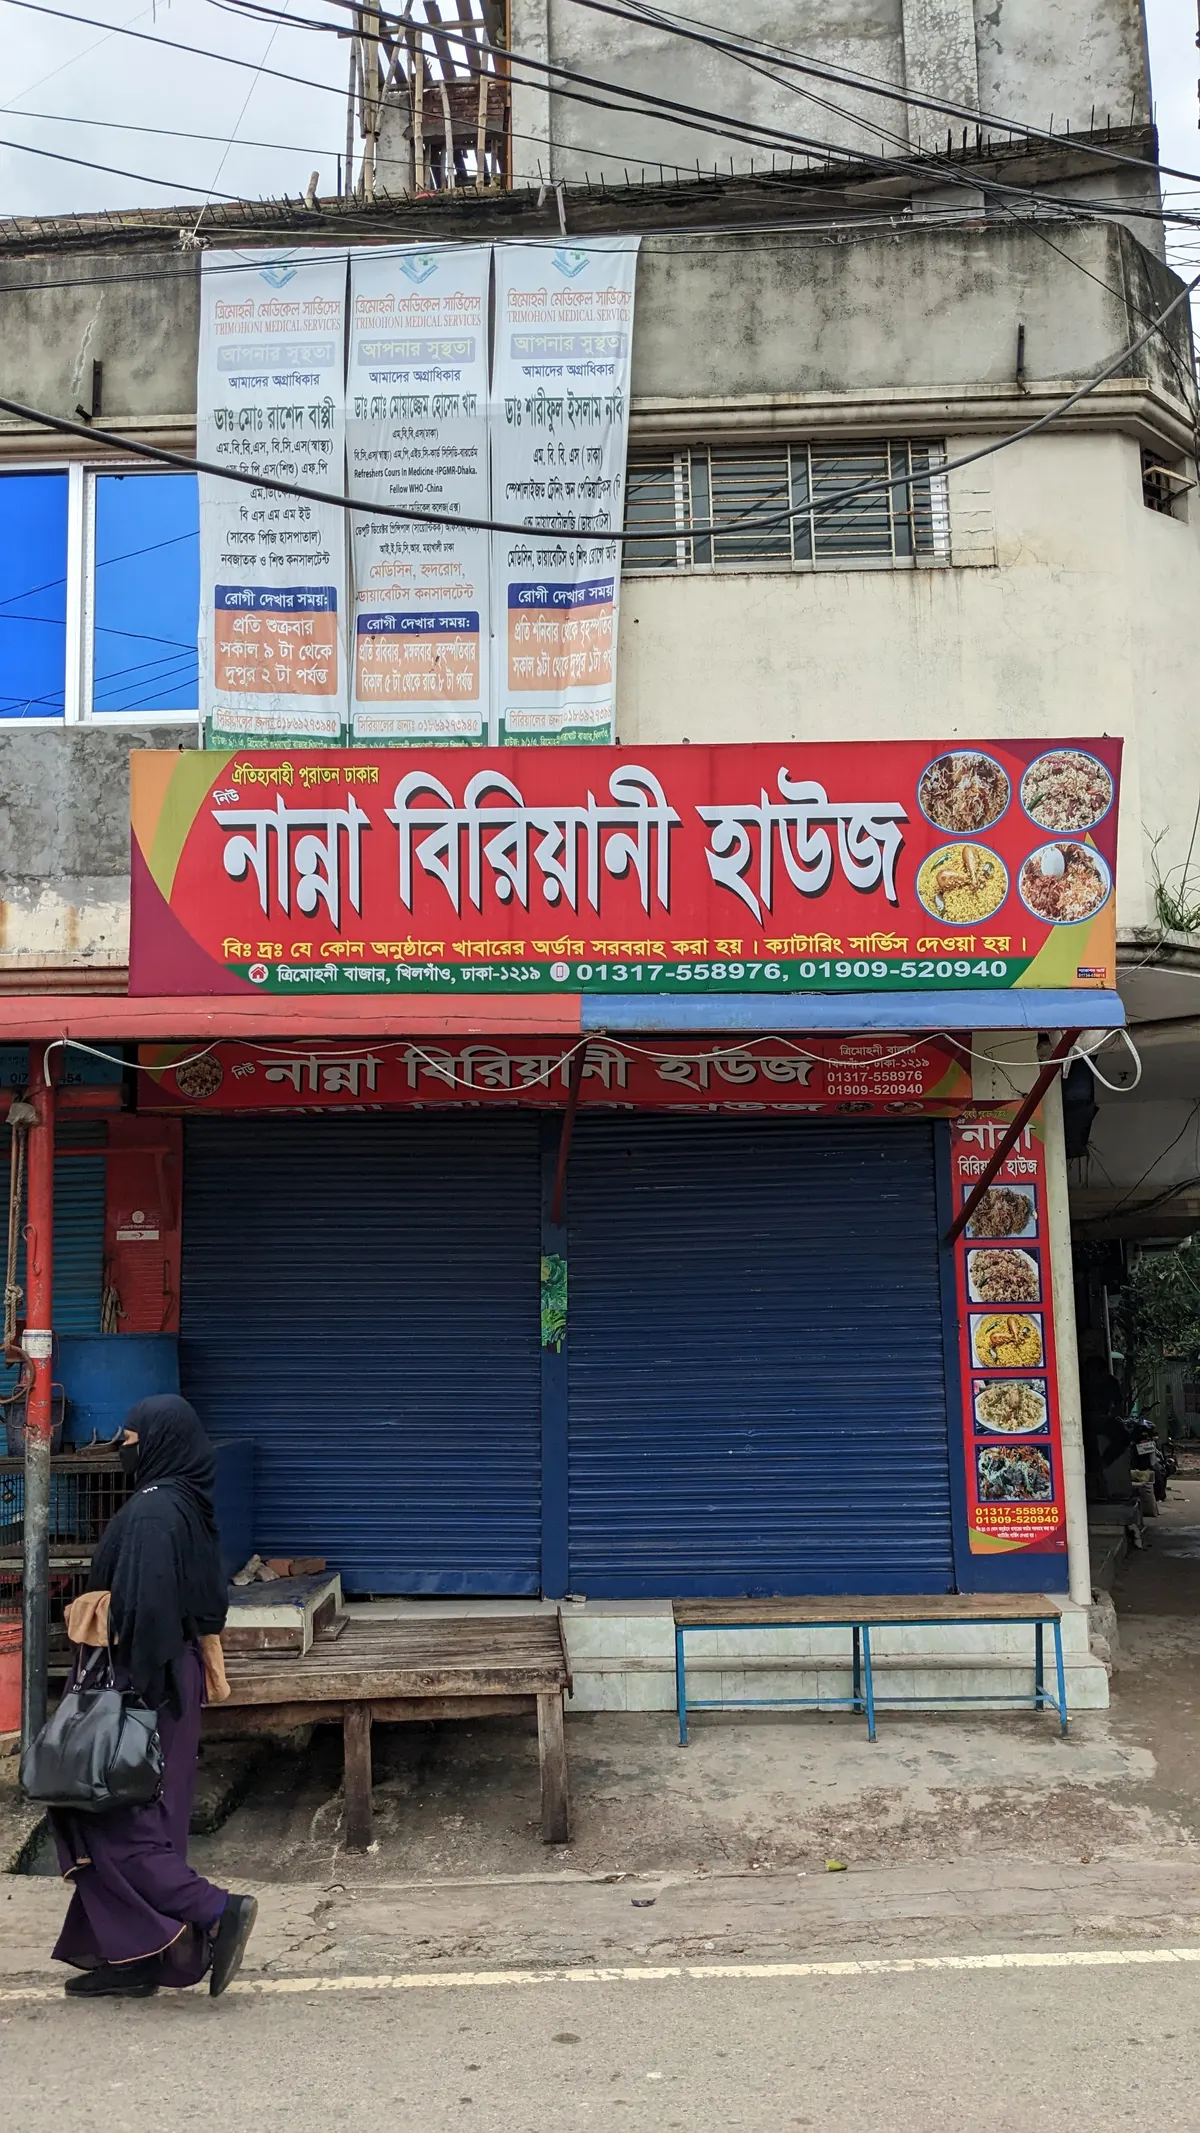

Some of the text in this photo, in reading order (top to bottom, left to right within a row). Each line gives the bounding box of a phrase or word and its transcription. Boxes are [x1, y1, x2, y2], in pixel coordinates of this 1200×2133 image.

[215, 296, 341, 319] ত্রিমোহনী মেডিকেল সার্ভিসেস
[355, 291, 481, 314] ত্রিমোহনী মেডিকেল সার্ভিসেস
[507, 287, 593, 308] ত্রিমোহনী মেডিকেল
[355, 314, 481, 329] TRIMOHONI MEDICAL SERVICES
[507, 309, 596, 323] TRIMOHONI MEDICAL
[214, 318, 341, 335] TRIMOHONI MEDICAL SERVICES
[222, 343, 333, 364] আপনার সুস্থতা
[361, 339, 472, 360] আপনার সুস্থতা
[513, 334, 626, 354] আপনার সুস্থতা
[229, 371, 320, 388] আমাদের অগ্রাধিকার
[369, 367, 462, 384] আমাদের অগ্রাধিকার
[522, 361, 615, 378] আমাদের অগ্রাধিকার
[354, 393, 368, 420] ডাঃ
[371, 393, 387, 420] মোঃ
[432, 391, 460, 422] হোসেন
[504, 387, 602, 431] ডাঃ ইসলাম
[213, 406, 234, 431] ডাঃ
[239, 405, 263, 431] মোঃ
[267, 404, 304, 430] রাশেদ
[354, 468, 383, 478] Refreshers
[384, 467, 400, 477] Cours
[402, 467, 408, 476] In
[408, 466, 434, 476] Medicine
[389, 484, 408, 494] Fellow
[409, 484, 423, 493] WHO
[239, 506, 311, 522] বি এস এম এম ইউ
[226, 529, 322, 546] (সাবেক পিজি হাসপাতাল)
[221, 554, 257, 566] নবজাতক
[260, 556, 266, 566] ও
[269, 552, 284, 568] শিশু
[370, 560, 416, 580] মেডিসিন,
[225, 589, 294, 608] রোগী দেখার
[357, 584, 411, 603] ডায়াবেটিস
[518, 586, 586, 604] রোগী দেখার
[233, 615, 314, 636] প্রতি শুক্রবার
[367, 615, 435, 631] রোগী দেখার
[515, 615, 531, 644] প্রতি
[220, 640, 333, 660] সকাল ৯ টা থেকে
[359, 637, 374, 662] প্রতি
[225, 663, 328, 686] দুপুর ২ টা পর্যন্ত
[512, 656, 535, 678] সকাল
[403, 672, 421, 692] থেকে
[422, 672, 436, 692] রাত
[231, 761, 379, 788] ঐতিহ্যবাহী পুরাতন ঢাকার
[212, 788, 240, 805] নিউ
[210, 764, 910, 932] নান্না বিরিয়ানী হাউজ
[221, 931, 1011, 961] বিঃ দ্রঃ যে কোন অনুষ্ঠানে খাবারের অর্ডার সরবরাহ করা হয় ক্যাটারিং সার্ভিস দেওয়া হয়
[276, 960, 1007, 985] ত্রিমোহনী বাজার, খিলগাঁও, ঢাকা-১২১৯ 01317-558976, 01909-520940
[840, 1044, 882, 1056] ত্রিমোহনী
[231, 1044, 817, 1096] নিউ নান্না বিরিয়ানী হাউজ
[827, 1070, 923, 1082] 01317-558976
[827, 1083, 923, 1095] 01909-520940
[1005, 1154, 1038, 1178] হাউজ
[975, 1507, 1059, 1516] 01317-558976
[975, 1515, 1059, 1524] 01909-520940
